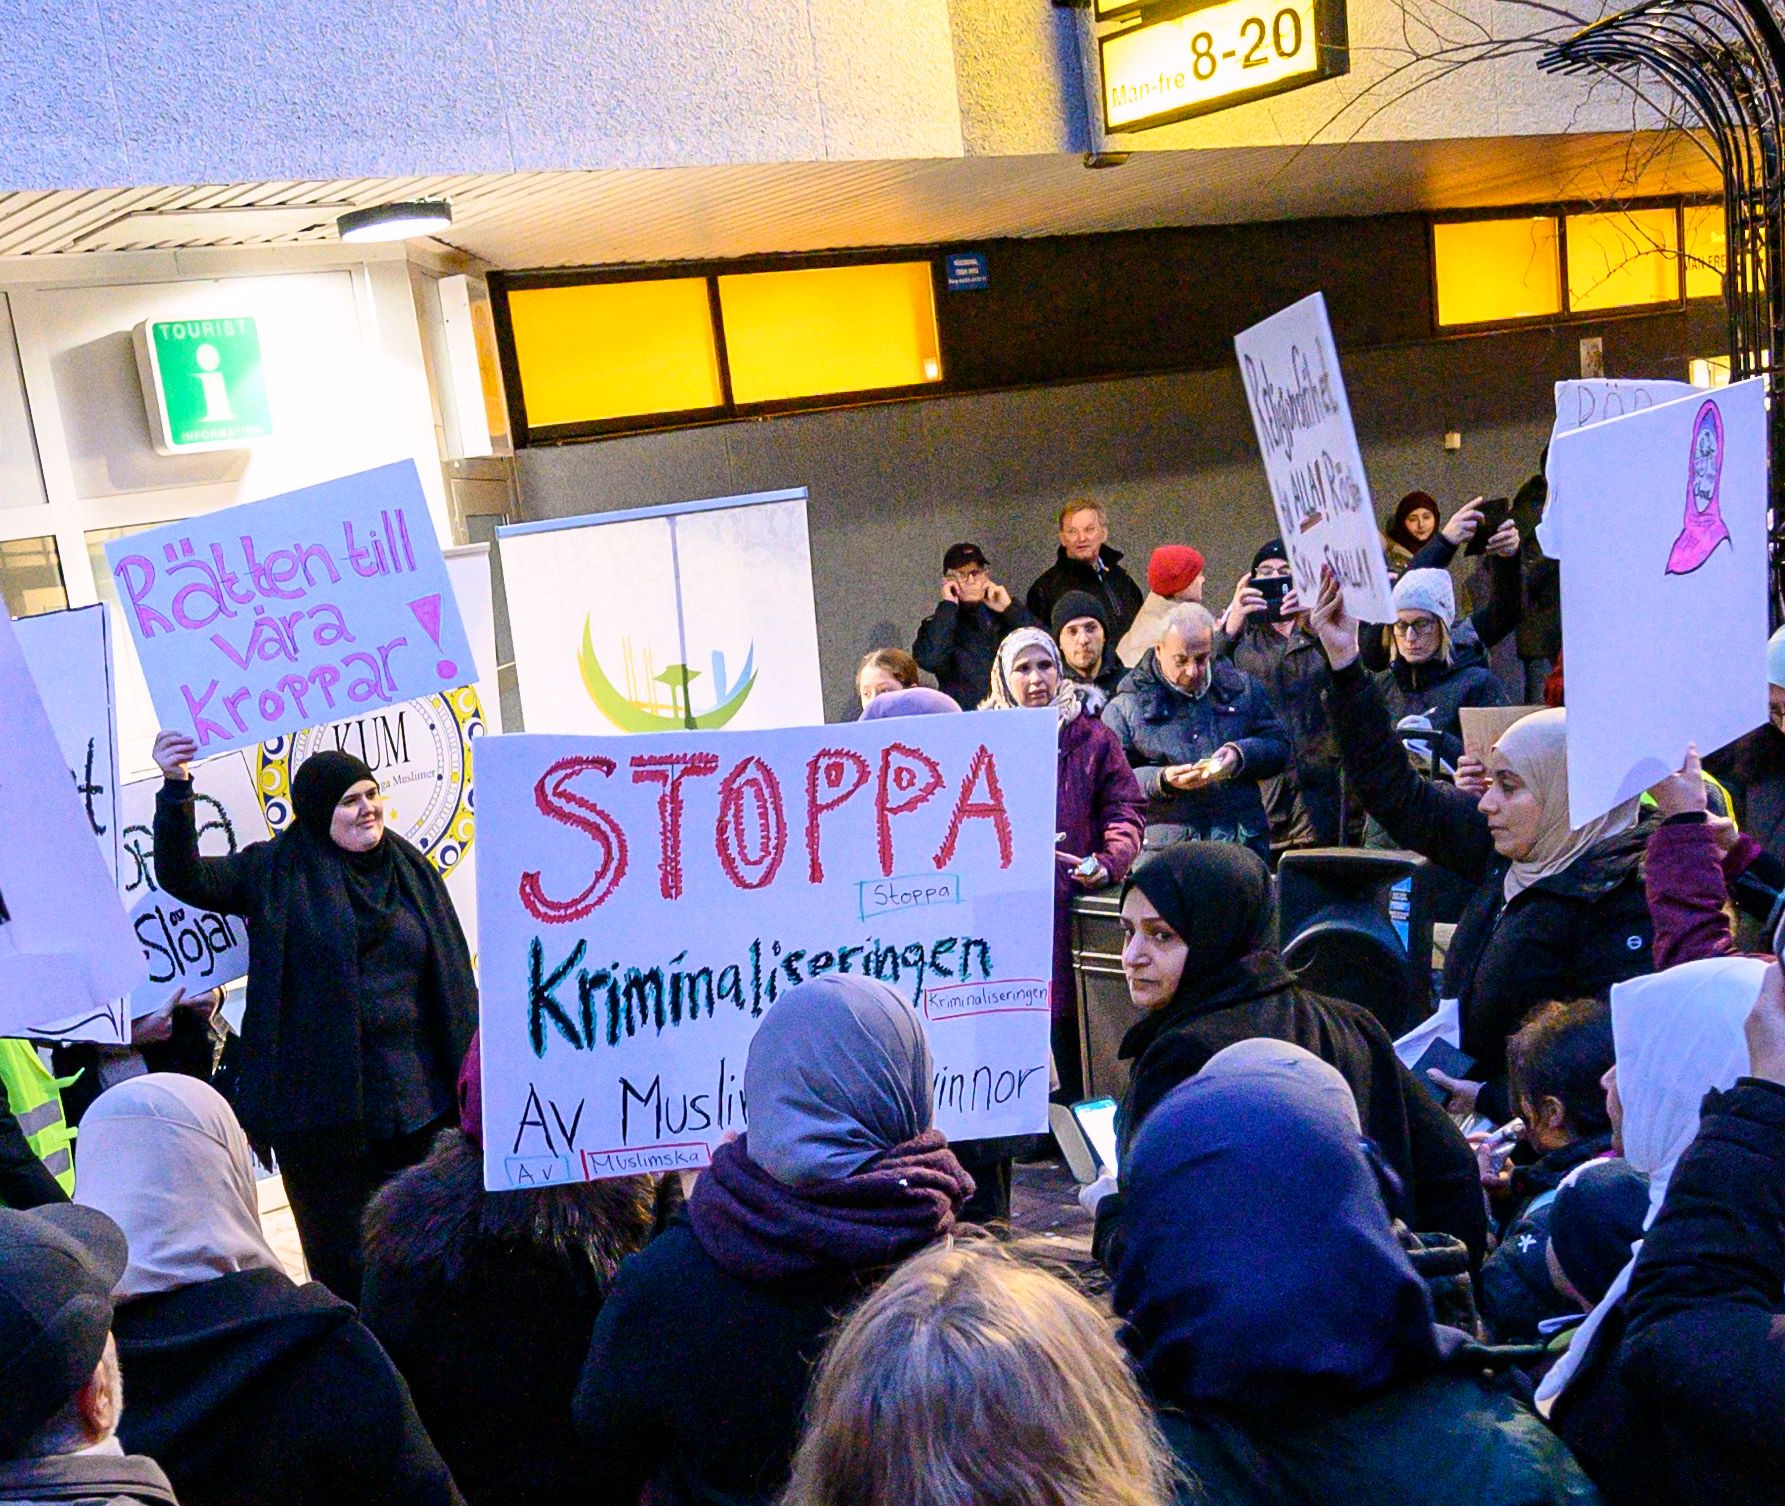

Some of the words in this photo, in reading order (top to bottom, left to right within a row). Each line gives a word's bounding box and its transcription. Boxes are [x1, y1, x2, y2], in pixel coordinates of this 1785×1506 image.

[1112, 73, 1185, 107] Man-fre
[1191, 8, 1302, 81] 8-20
[159, 319, 247, 341] TOURIST
[114, 537, 341, 638] Rätten
[341, 509, 418, 578] till
[393, 769, 436, 786] Muslimer
[520, 742, 1014, 925] STOPPA
[874, 882, 950, 906] Stoppa
[527, 935, 995, 1059] Kriminaliseringen
[929, 986, 1048, 1009] Kriminaliseringen
[619, 1058, 748, 1146] Musli
[933, 1065, 1045, 1113] innor
[590, 1150, 700, 1175] Muslimska
